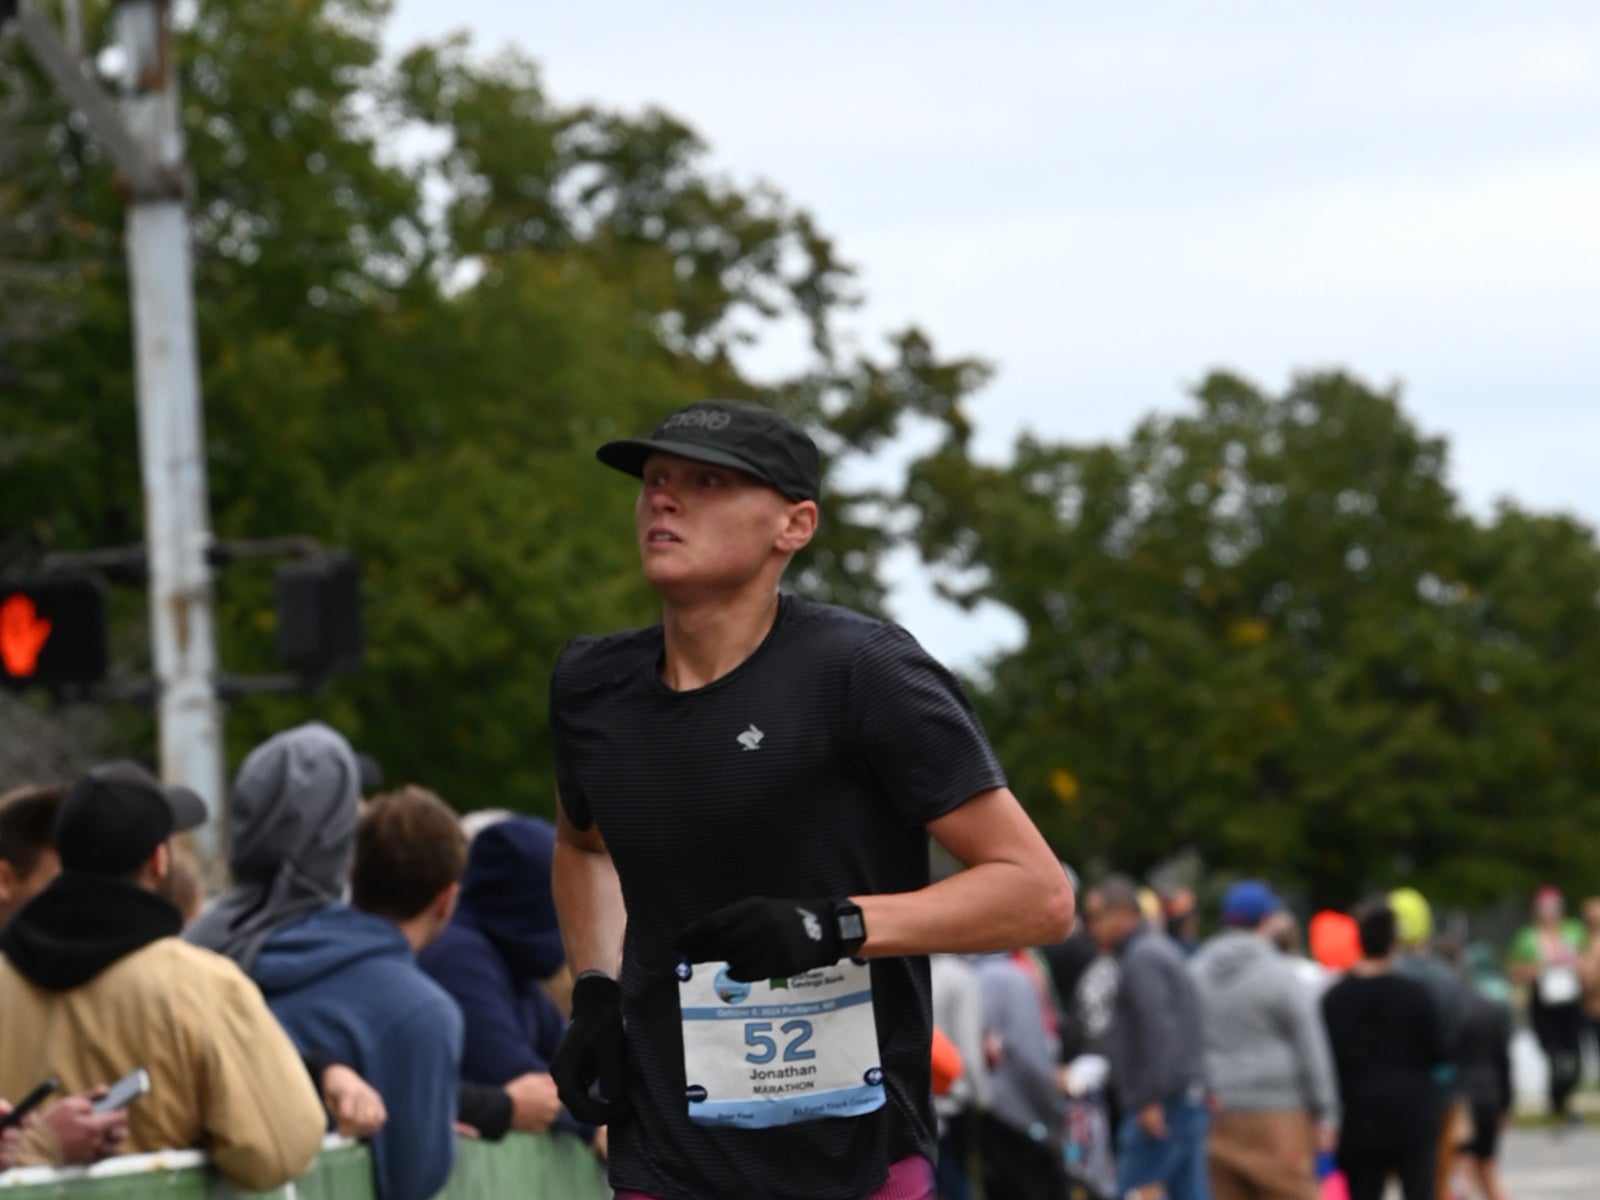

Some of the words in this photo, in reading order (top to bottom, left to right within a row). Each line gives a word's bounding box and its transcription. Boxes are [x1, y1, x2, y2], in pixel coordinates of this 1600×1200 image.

[745, 1019, 816, 1065] 52
[750, 1065, 817, 1081] Jonathan
[753, 1081, 814, 1094] MARATHON
